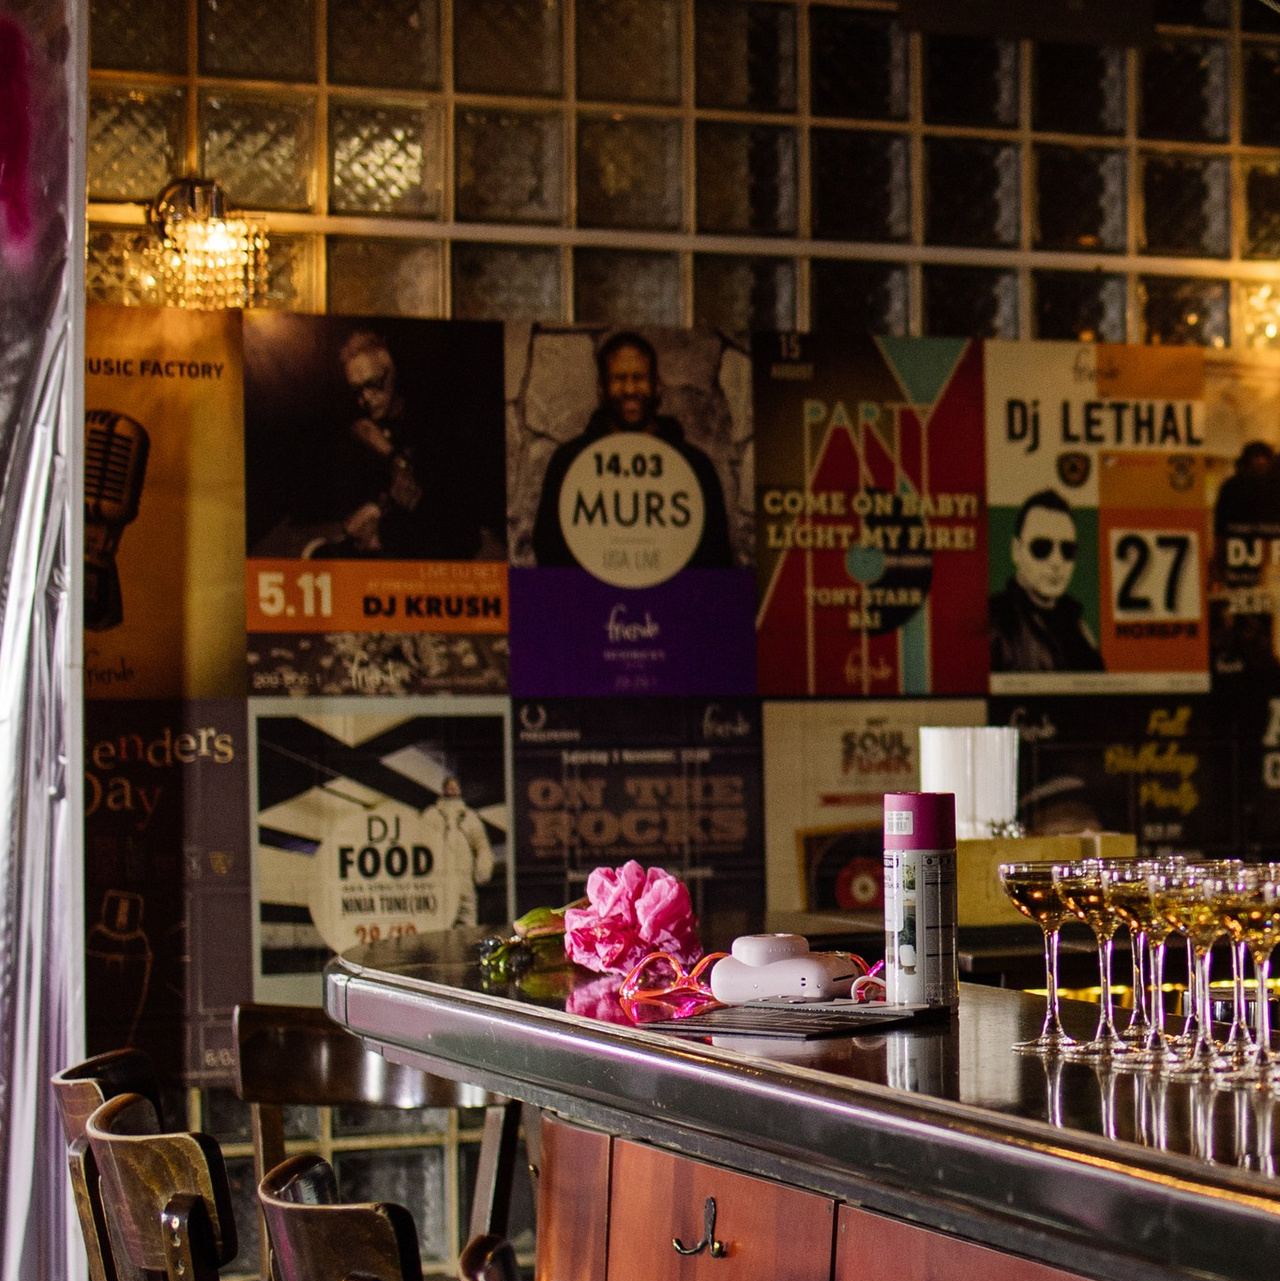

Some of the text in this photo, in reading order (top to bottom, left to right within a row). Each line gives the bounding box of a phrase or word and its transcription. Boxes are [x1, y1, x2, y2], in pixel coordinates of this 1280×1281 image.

[85, 358, 224, 380] USIC FACTORY
[1062, 400, 1204, 445] LETHAL
[594, 453, 663, 477] 14.03
[573, 490, 691, 528] MURS
[763, 490, 979, 518] COME ON BABY!
[767, 523, 977, 551] LIGHT MY FIRE!
[1226, 538, 1263, 568] DJ
[1117, 534, 1189, 612] 27
[257, 571, 333, 618] 5.11
[363, 596, 501, 618] DJ KRUSH
[92, 725, 235, 768] enders
[527, 776, 745, 809] ON THE
[367, 815, 400, 843] DJ
[528, 807, 748, 848] ROCKS
[339, 845, 433, 879] FOOD
